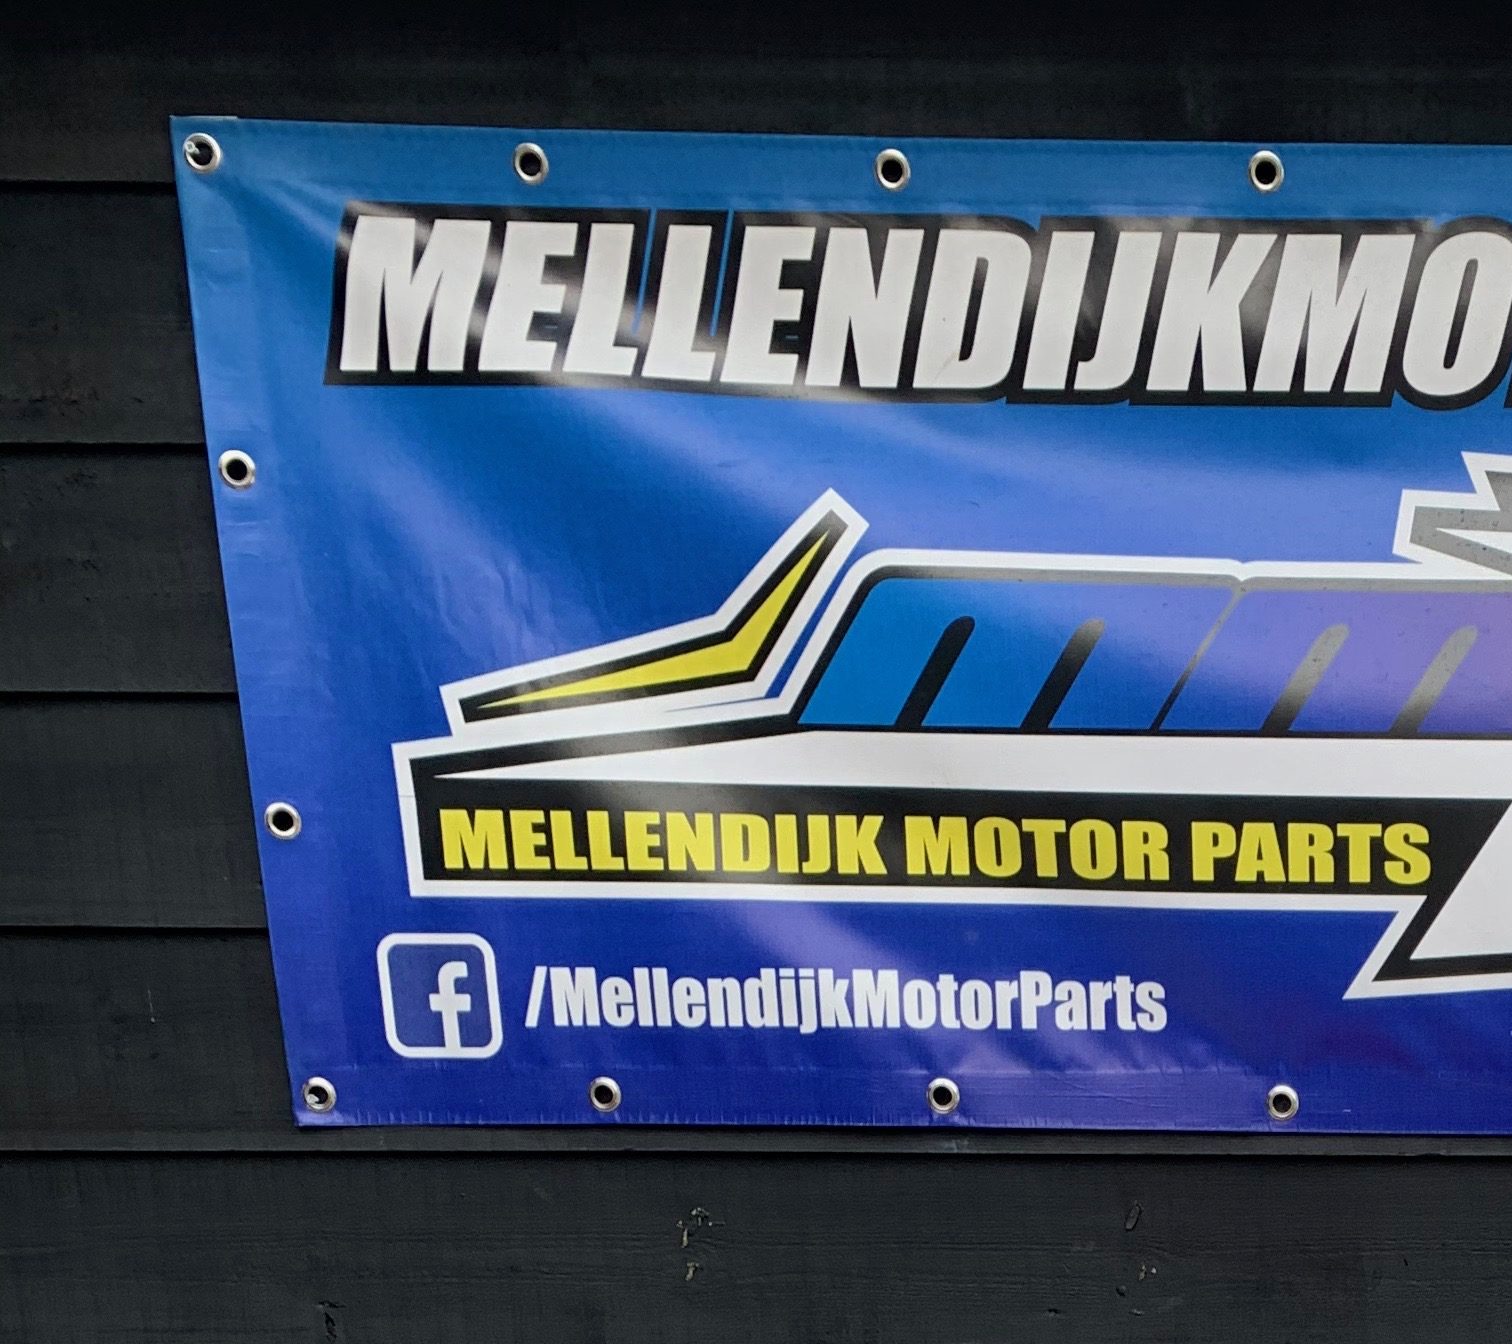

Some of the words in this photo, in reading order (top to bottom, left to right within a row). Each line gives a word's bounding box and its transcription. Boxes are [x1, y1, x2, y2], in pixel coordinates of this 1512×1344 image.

[438, 806, 889, 878] MELLENDIJK
[904, 813, 1170, 882] MOTOR
[1191, 820, 1433, 885] PARTS
[524, 963, 1168, 1033] /MellendijkMotorParts
